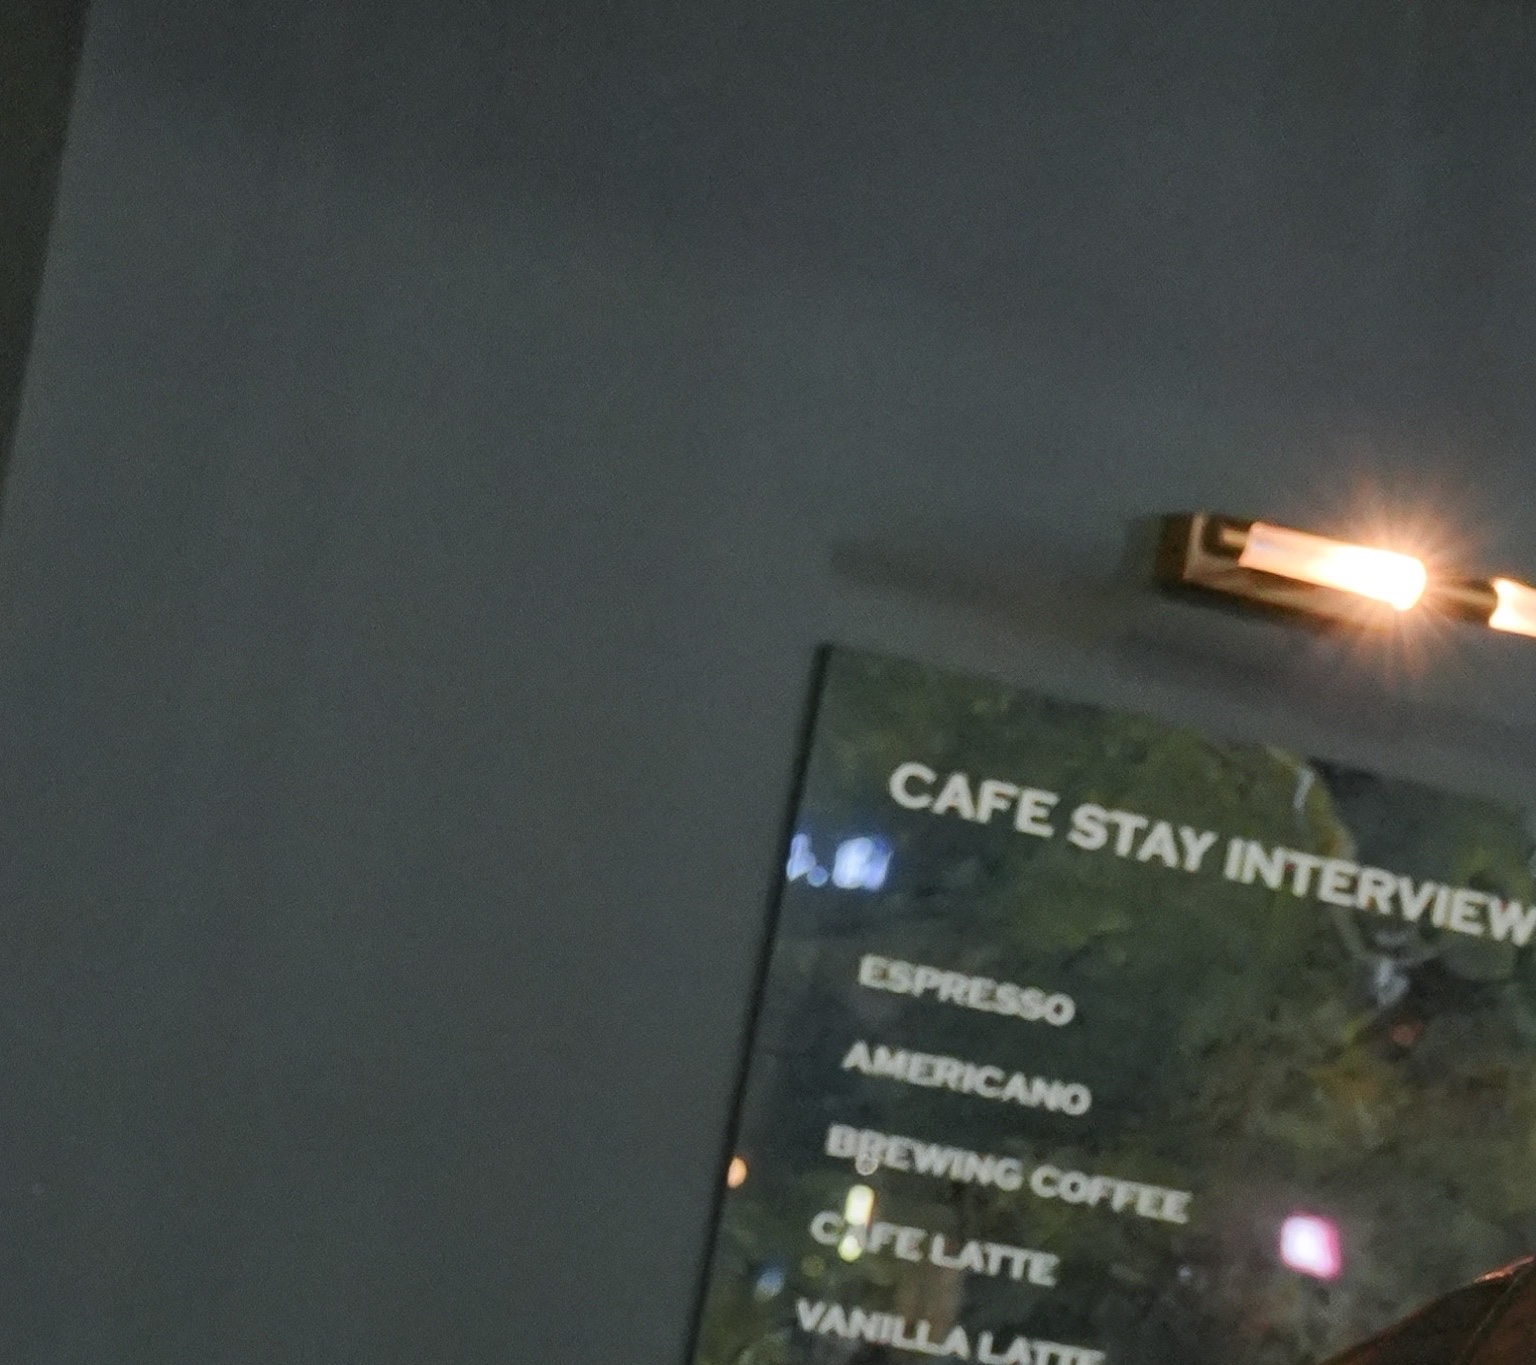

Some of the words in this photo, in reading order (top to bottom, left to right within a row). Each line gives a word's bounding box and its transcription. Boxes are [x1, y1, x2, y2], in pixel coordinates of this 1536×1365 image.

[889, 761, 1060, 838] CAFE
[1068, 802, 1211, 873] STAY
[859, 953, 1076, 1026] ESPRESSO
[842, 1039, 1092, 1116] AMERICANO
[825, 1123, 1024, 1191] BREWING
[1030, 1164, 1193, 1225] COFFEE
[930, 1234, 1060, 1287] LATTE
[797, 1298, 971, 1360] VANILLA
